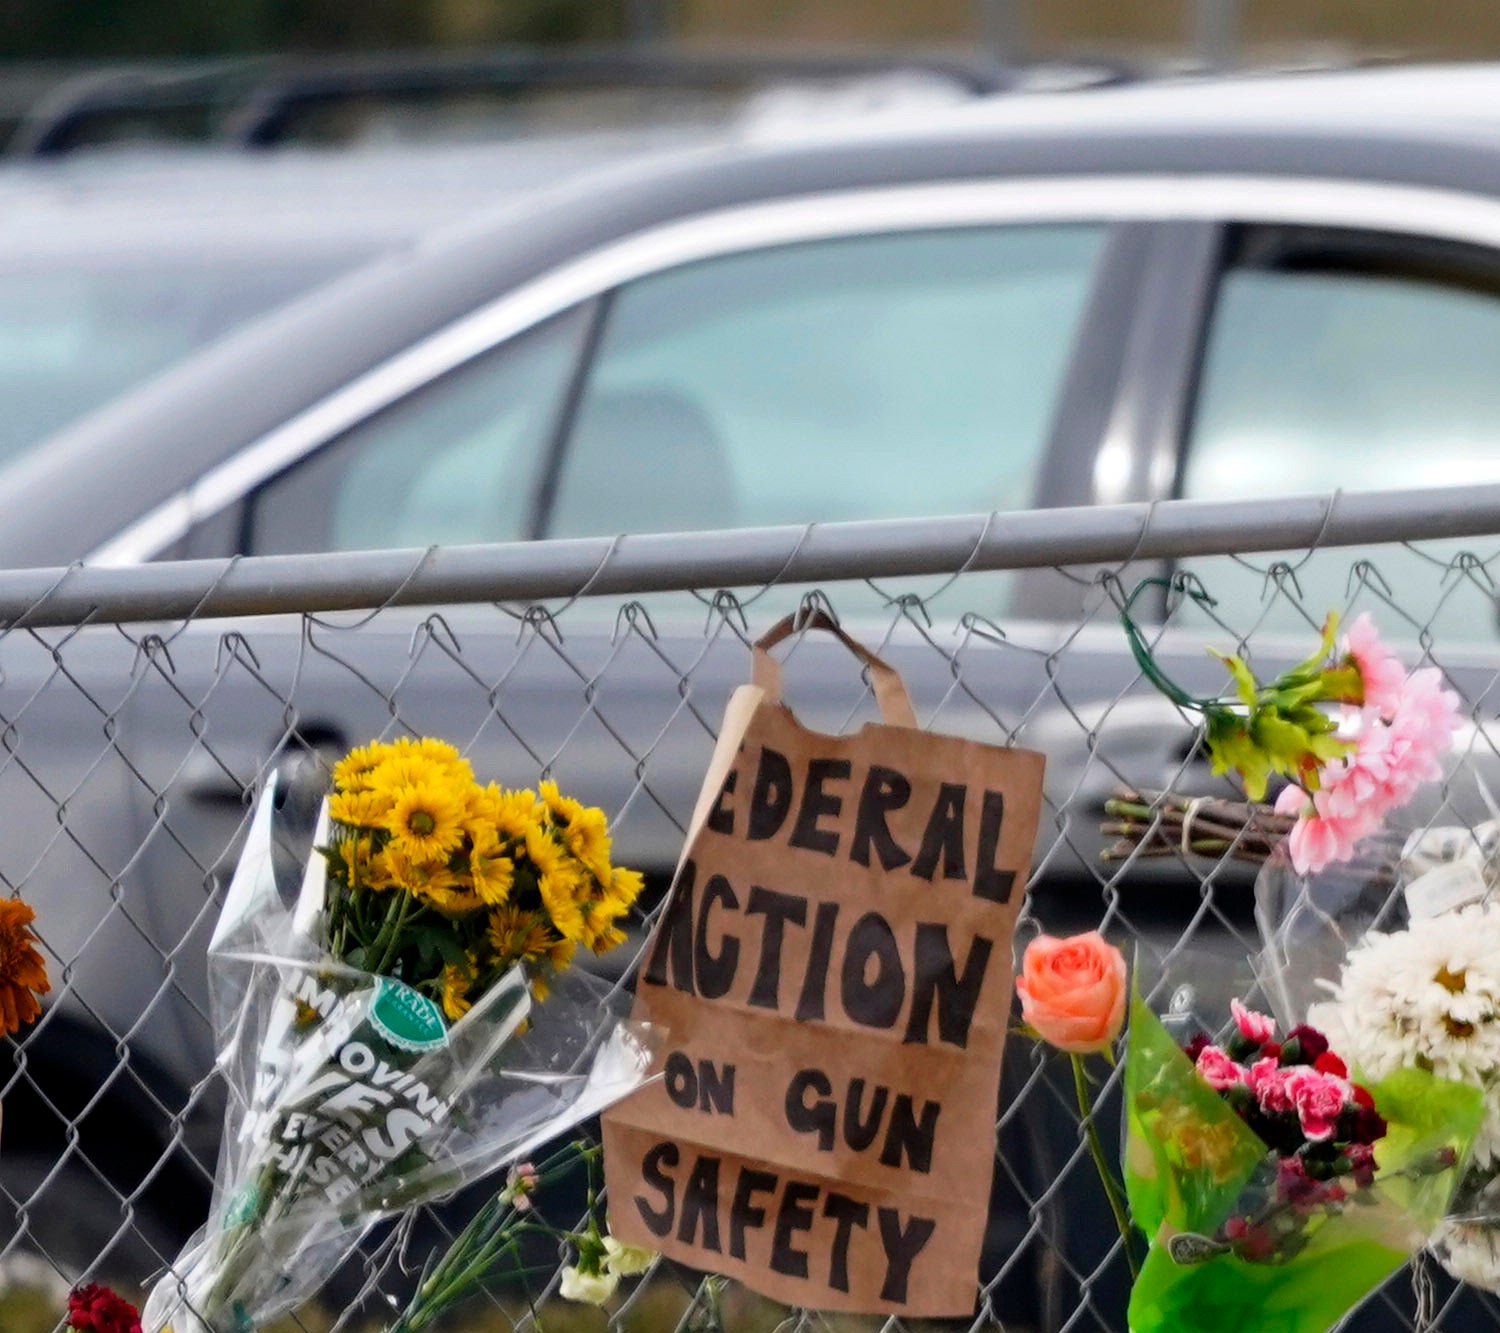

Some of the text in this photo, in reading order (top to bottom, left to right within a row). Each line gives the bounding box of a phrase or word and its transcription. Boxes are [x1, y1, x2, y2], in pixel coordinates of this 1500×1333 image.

[706, 743, 1017, 903] EDERAL
[386, 982, 437, 1029] TRADE
[644, 859, 994, 1048] ACTION
[664, 1051, 940, 1173] ON GUN
[634, 1143, 936, 1305] SAFETY
